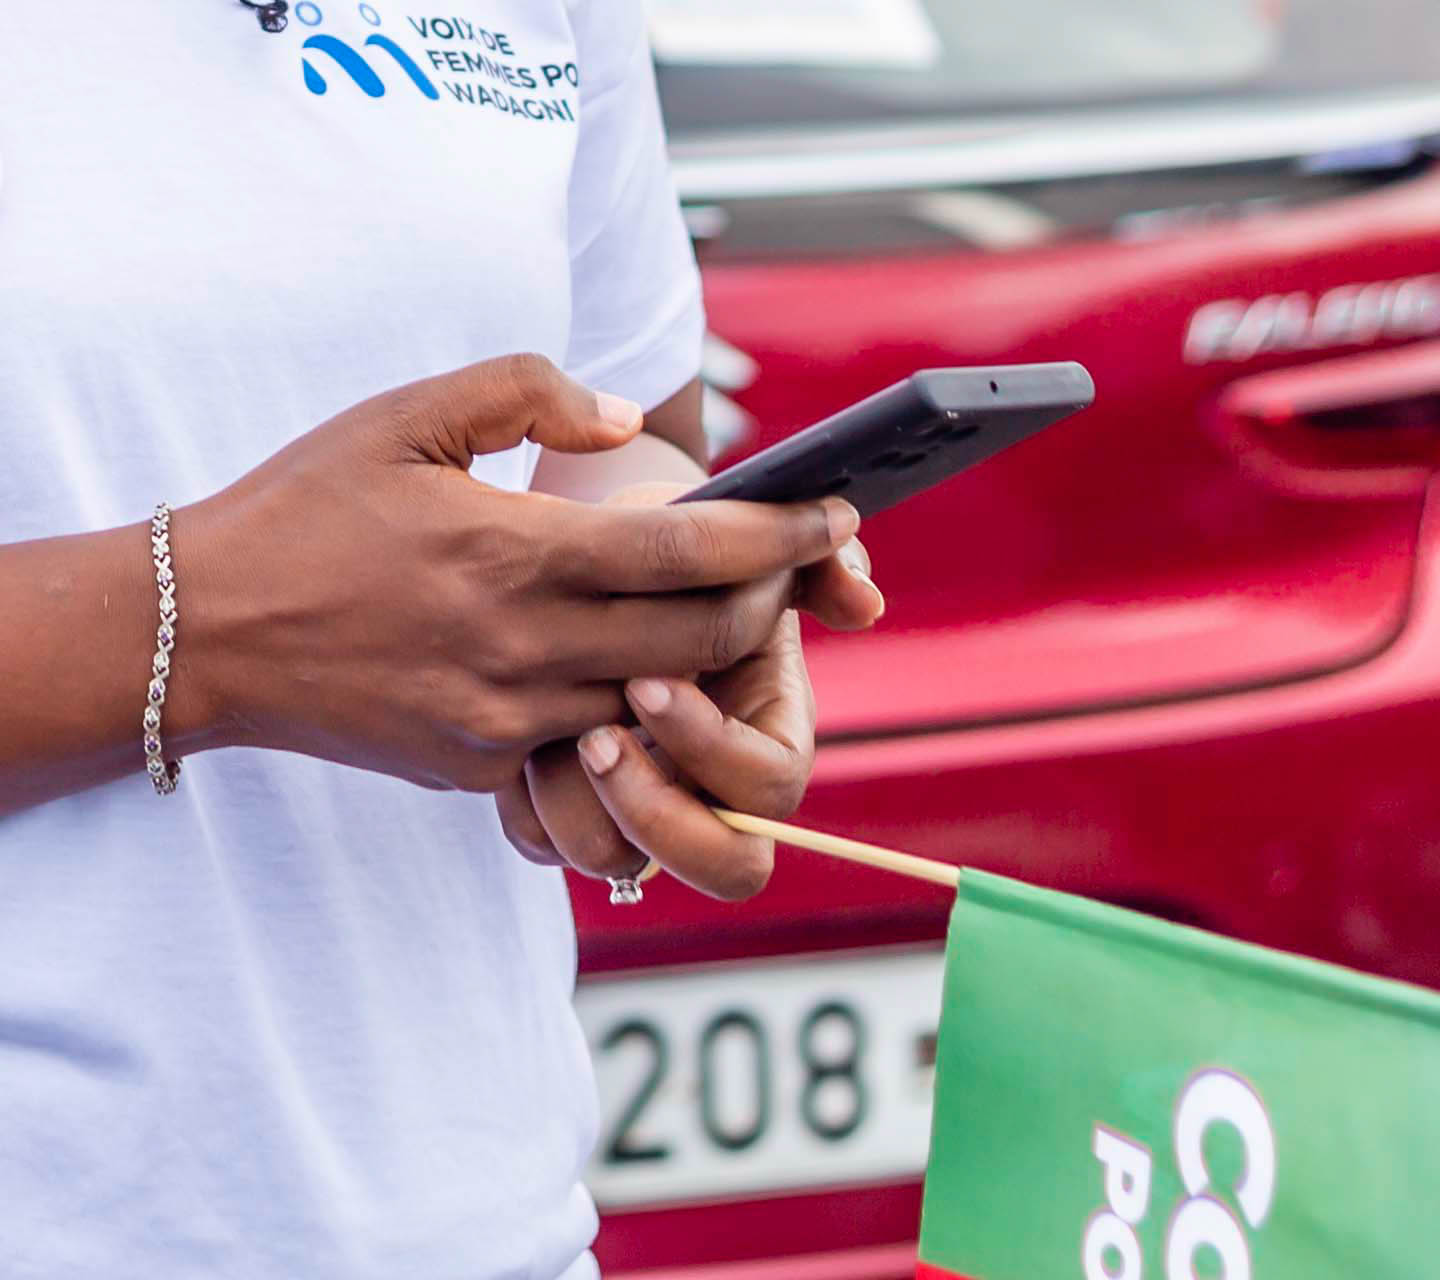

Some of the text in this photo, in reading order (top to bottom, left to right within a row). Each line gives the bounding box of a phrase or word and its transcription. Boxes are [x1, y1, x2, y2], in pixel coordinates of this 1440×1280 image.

[406, 15, 515, 56] VOIX DE
[425, 49, 537, 89] FEMMES
[442, 80, 575, 122] WADAGNI
[600, 998, 868, 1166] 208
